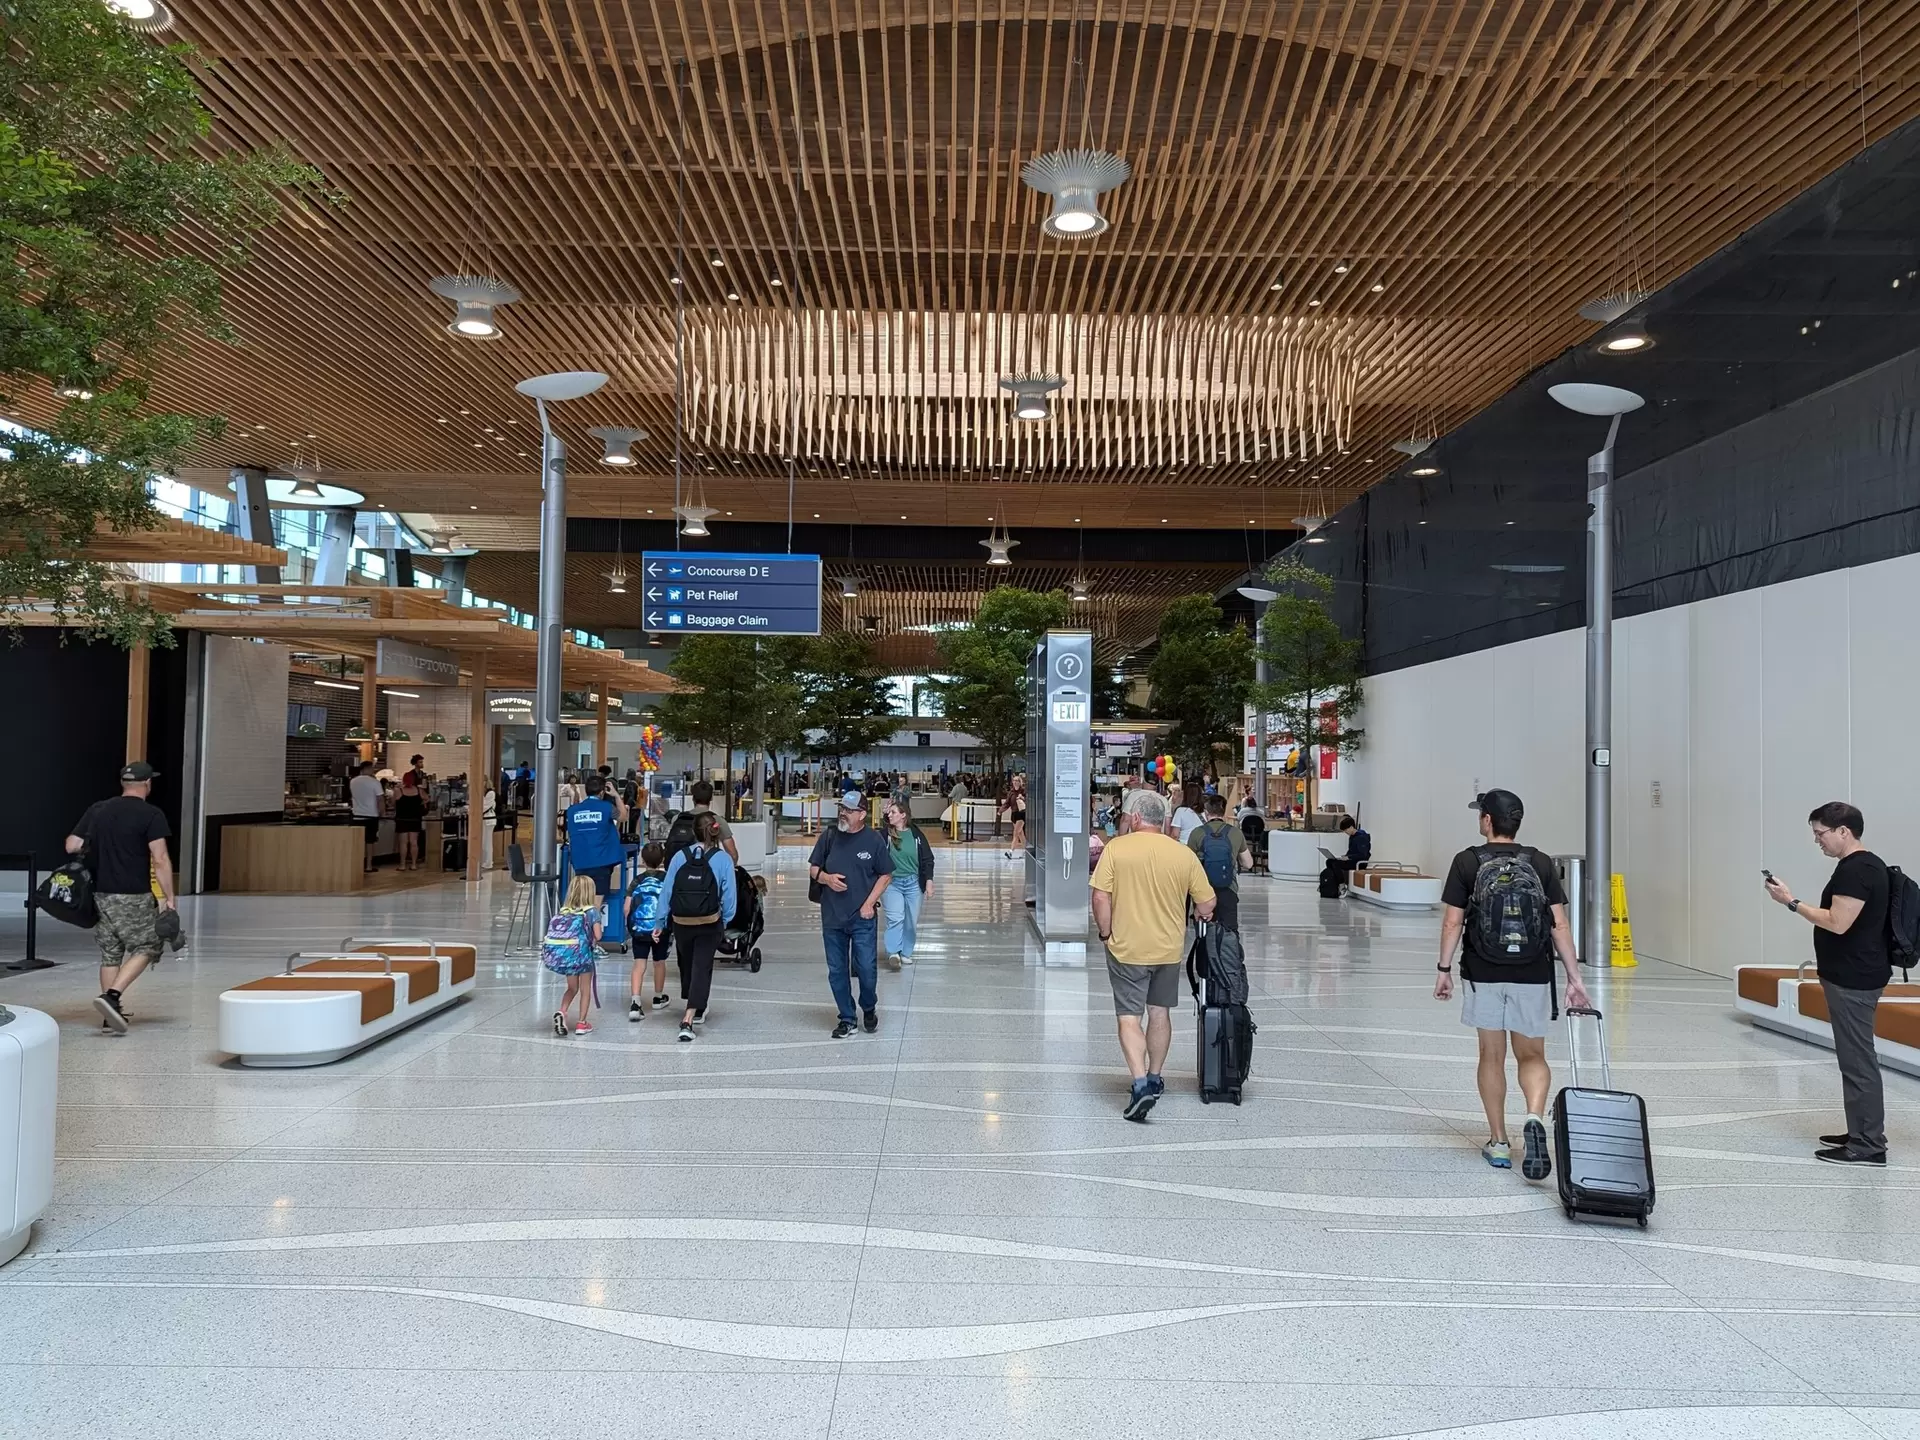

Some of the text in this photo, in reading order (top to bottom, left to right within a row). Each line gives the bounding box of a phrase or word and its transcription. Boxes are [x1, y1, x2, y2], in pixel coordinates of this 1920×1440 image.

[688, 566, 769, 577] Concourse D E
[687, 590, 739, 601] Pet Relief
[687, 615, 768, 626] Baggage Claim
[384, 652, 459, 675] STUMPTOWN
[490, 698, 532, 706] STUMPTOWN
[1060, 704, 1080, 719] EXIT
[921, 736, 926, 744] 6
